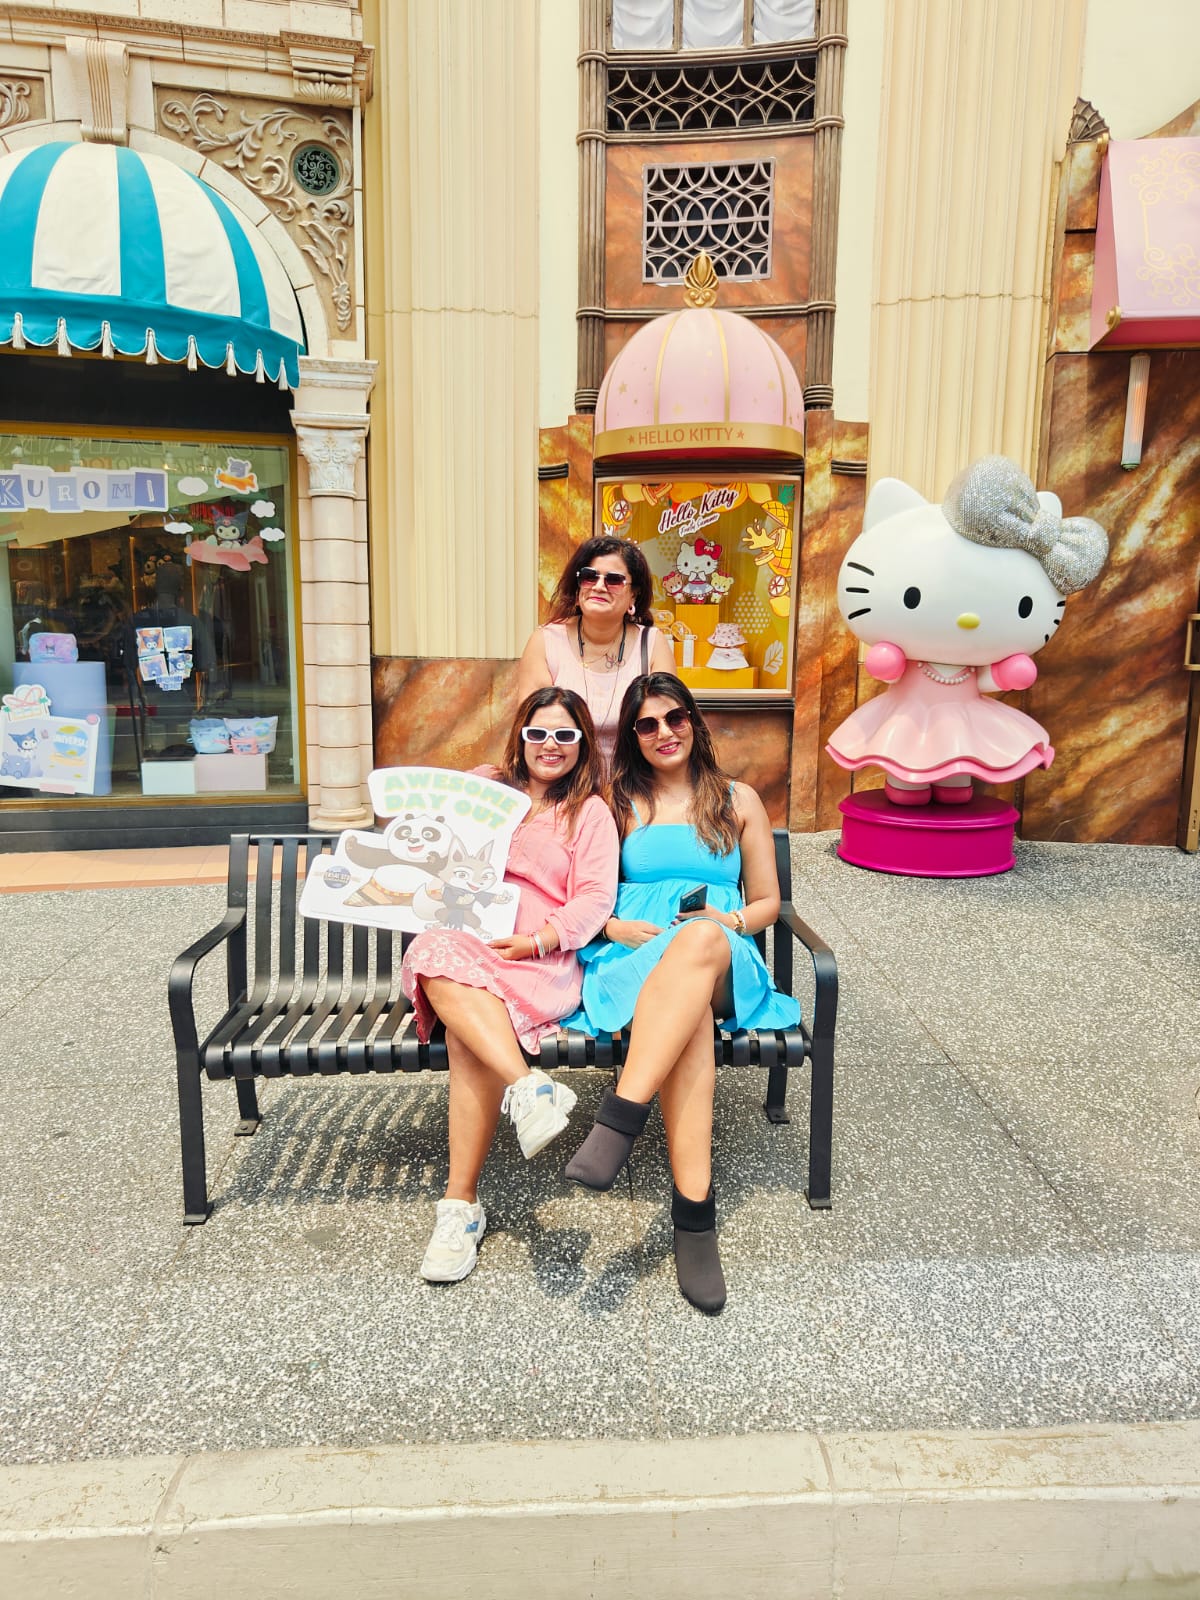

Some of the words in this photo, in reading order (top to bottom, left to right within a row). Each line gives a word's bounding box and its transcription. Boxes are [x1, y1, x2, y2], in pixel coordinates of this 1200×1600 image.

[638, 428, 685, 445] HELLO
[689, 427, 734, 442] KITTY
[0, 478, 155, 507] KUROMI
[659, 502, 697, 532] Hello
[701, 489, 738, 514] Kitty
[384, 773, 518, 815] AWESOME
[384, 793, 448, 812] DAY
[453, 799, 507, 831] OUT
